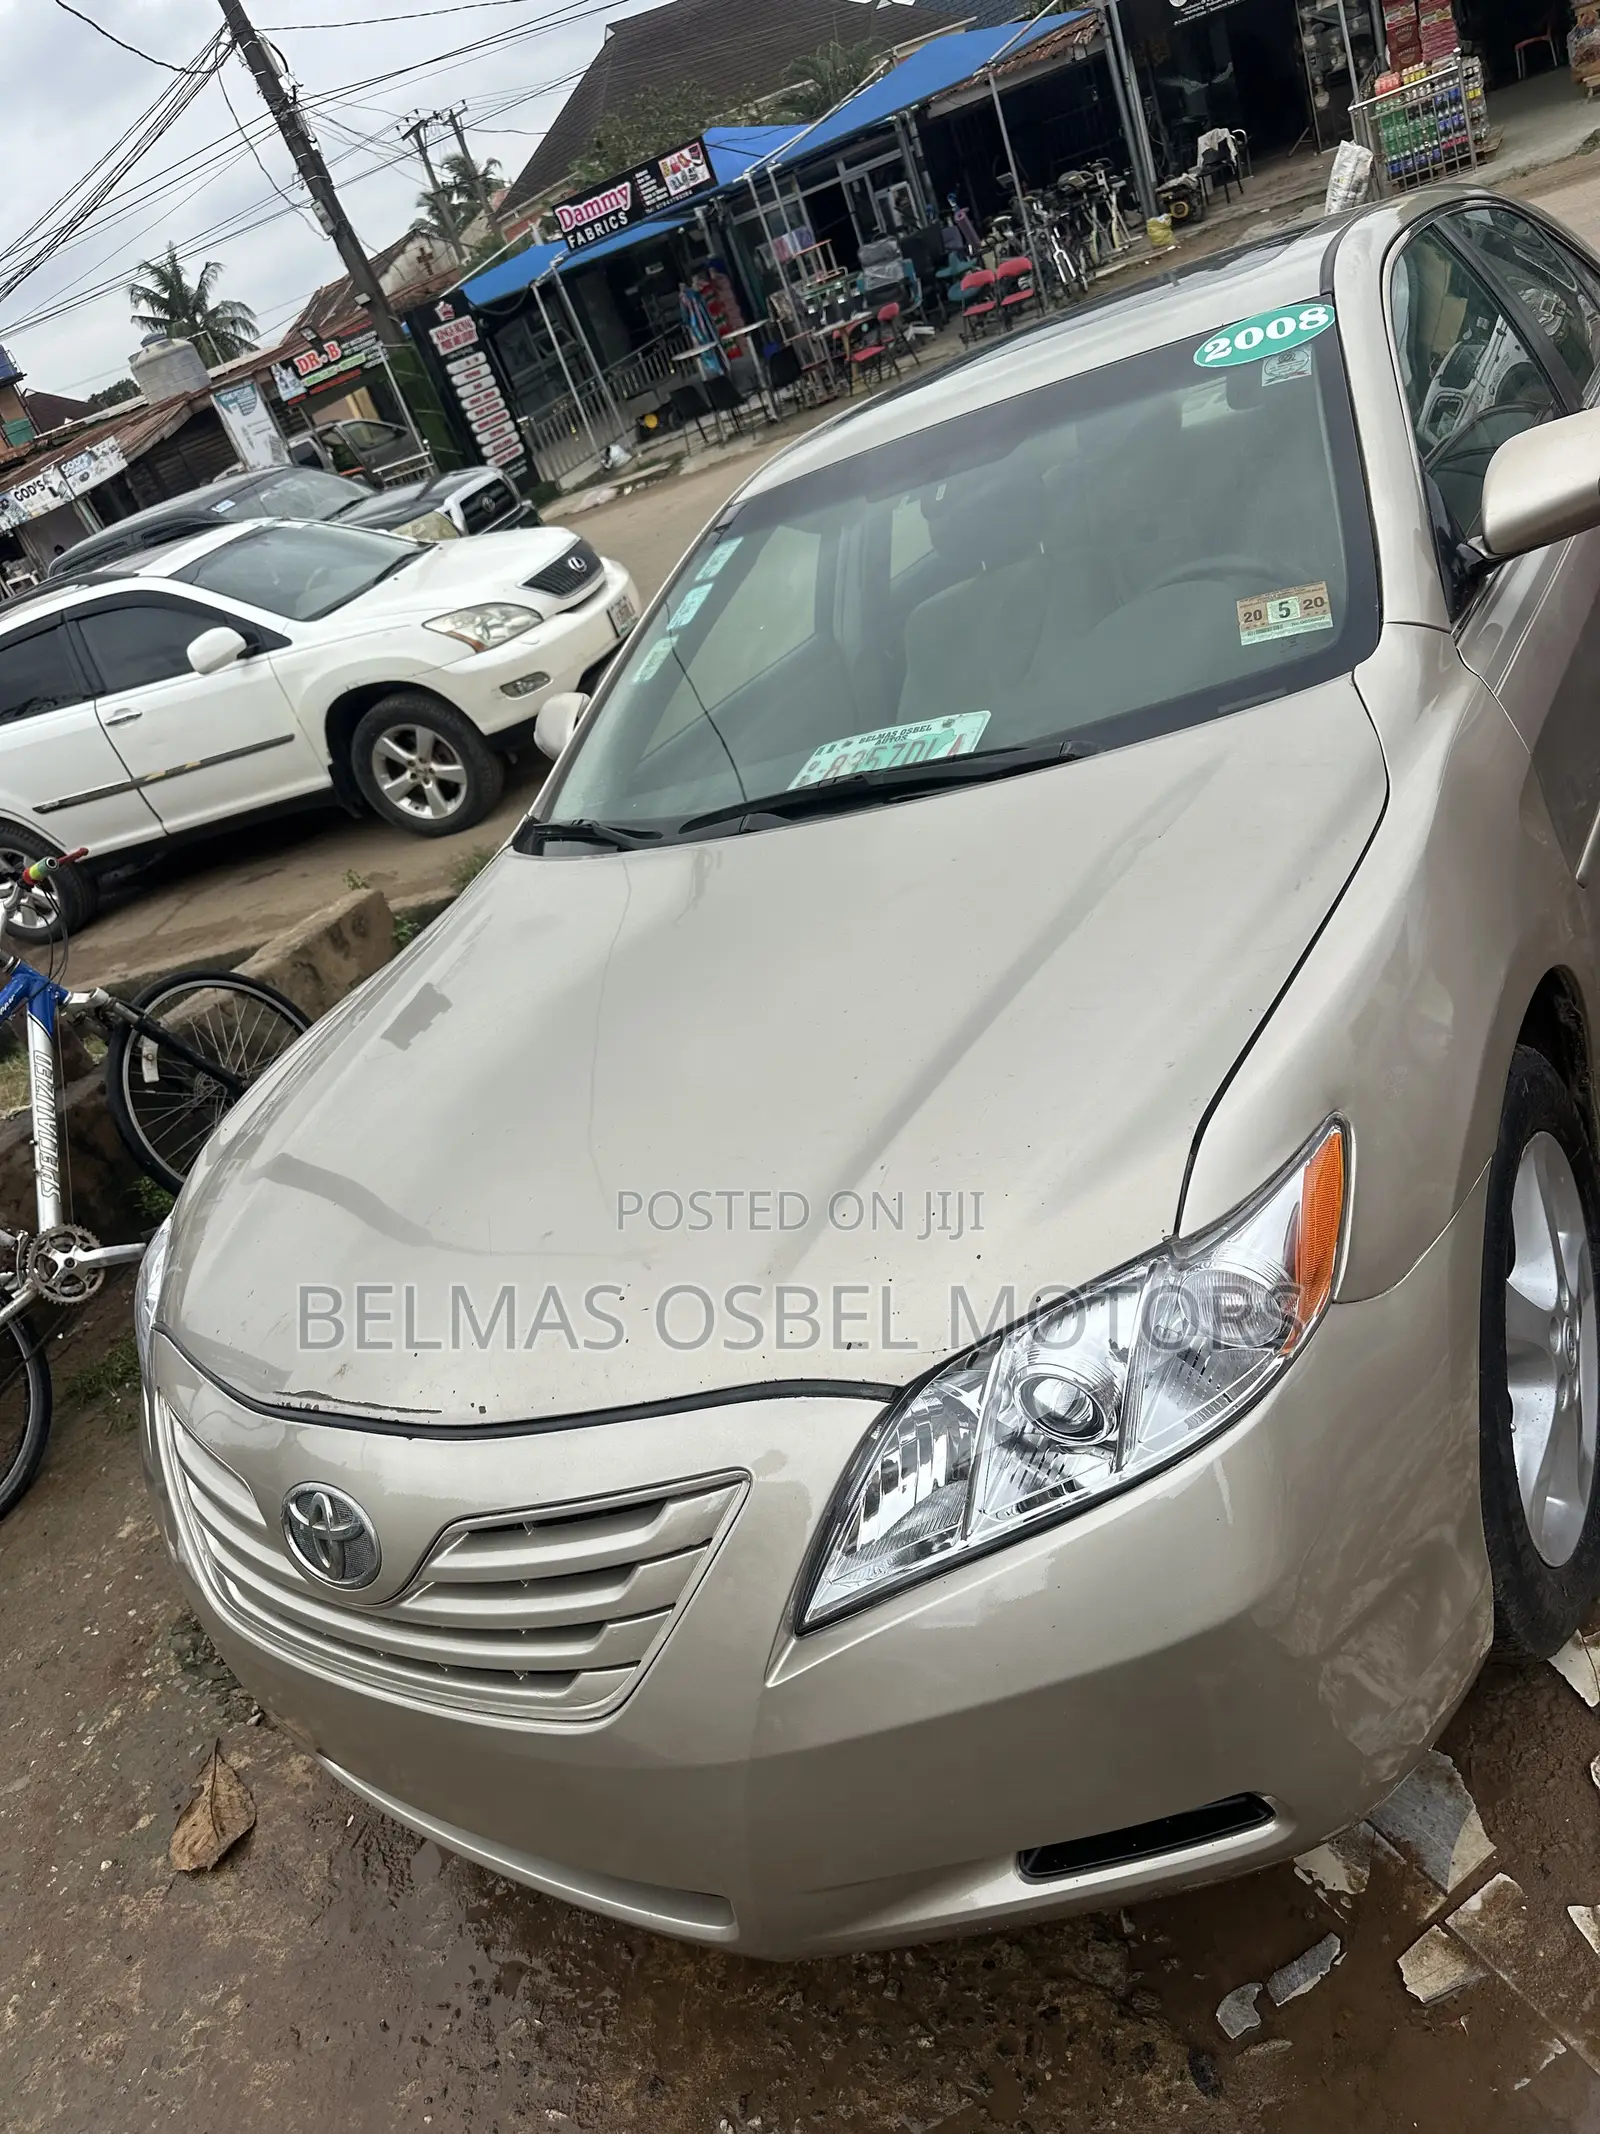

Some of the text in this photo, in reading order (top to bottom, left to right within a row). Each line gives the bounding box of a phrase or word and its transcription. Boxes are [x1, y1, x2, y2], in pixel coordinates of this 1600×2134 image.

[556, 182, 631, 232] Dammy
[567, 211, 628, 249] FABRICS
[1204, 306, 1329, 363] 2008
[14, 479, 46, 502] GOD'S
[1243, 596, 1325, 624] 20 5 20
[858, 724, 932, 745] BELMAS OSBEL
[875, 734, 908, 746] AUTOS
[34, 1050, 61, 1204] SPECIALIZED
